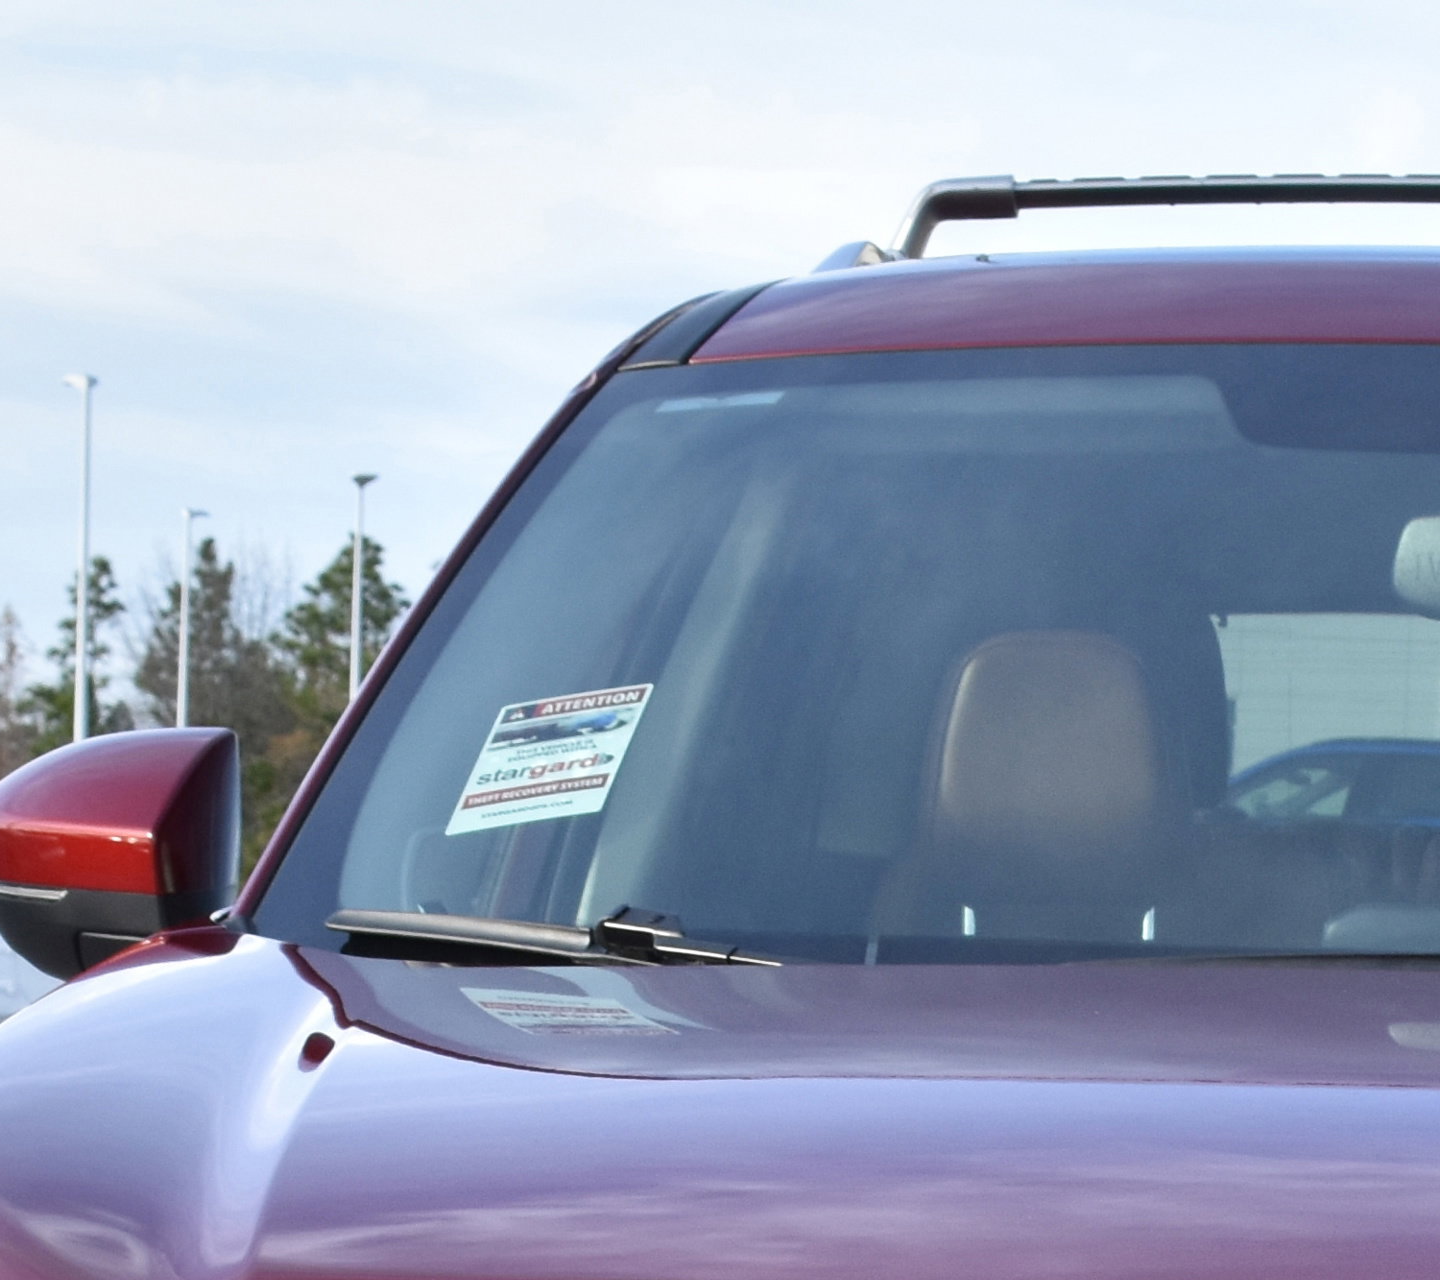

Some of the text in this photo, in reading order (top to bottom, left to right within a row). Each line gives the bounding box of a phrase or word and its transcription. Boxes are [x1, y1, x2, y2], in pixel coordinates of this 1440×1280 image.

[541, 691, 640, 714] ATTENTION
[476, 753, 599, 786] stargard
[468, 777, 603, 806] THEFT RECOVERY SYSTEM
